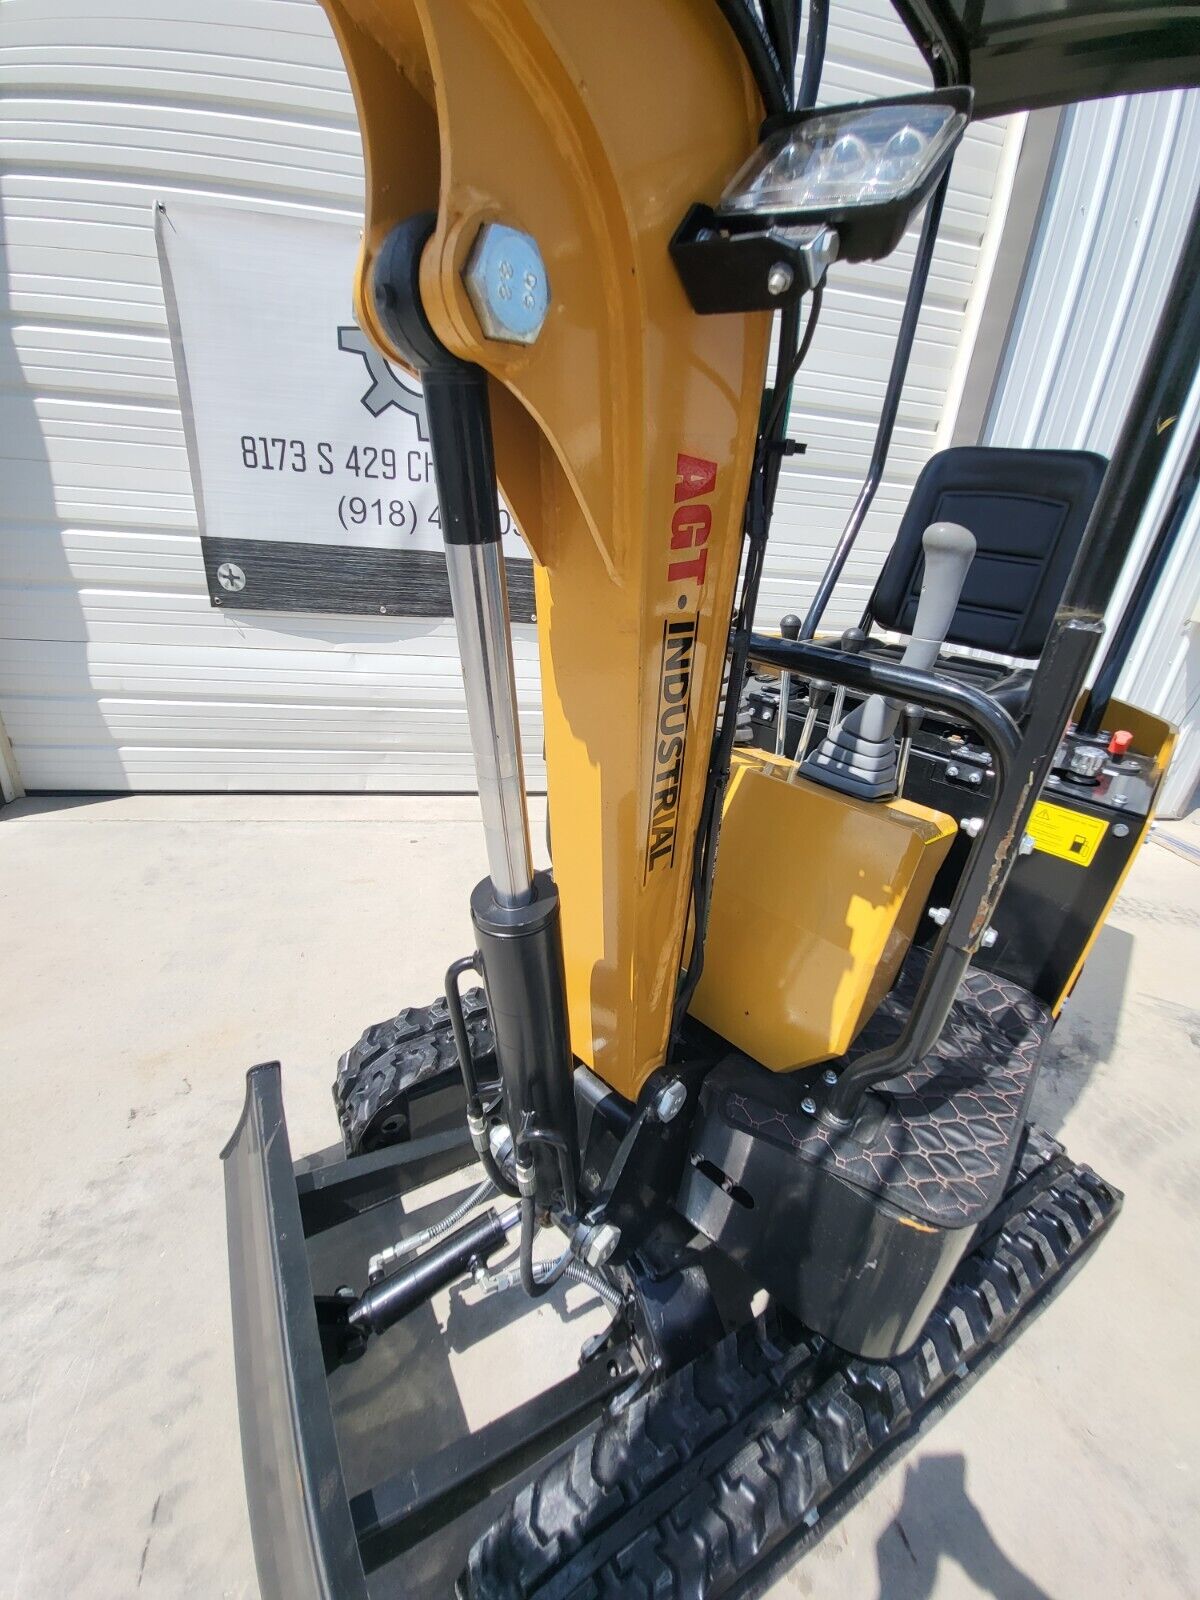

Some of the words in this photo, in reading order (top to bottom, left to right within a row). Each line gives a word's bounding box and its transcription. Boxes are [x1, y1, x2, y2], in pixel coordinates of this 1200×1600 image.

[240, 435, 306, 473] 8173
[317, 442, 334, 475] S
[345, 445, 396, 480] 429
[338, 495, 418, 535] (918)
[667, 452, 718, 586] AGT
[648, 620, 695, 872] INDUSTRIAL
